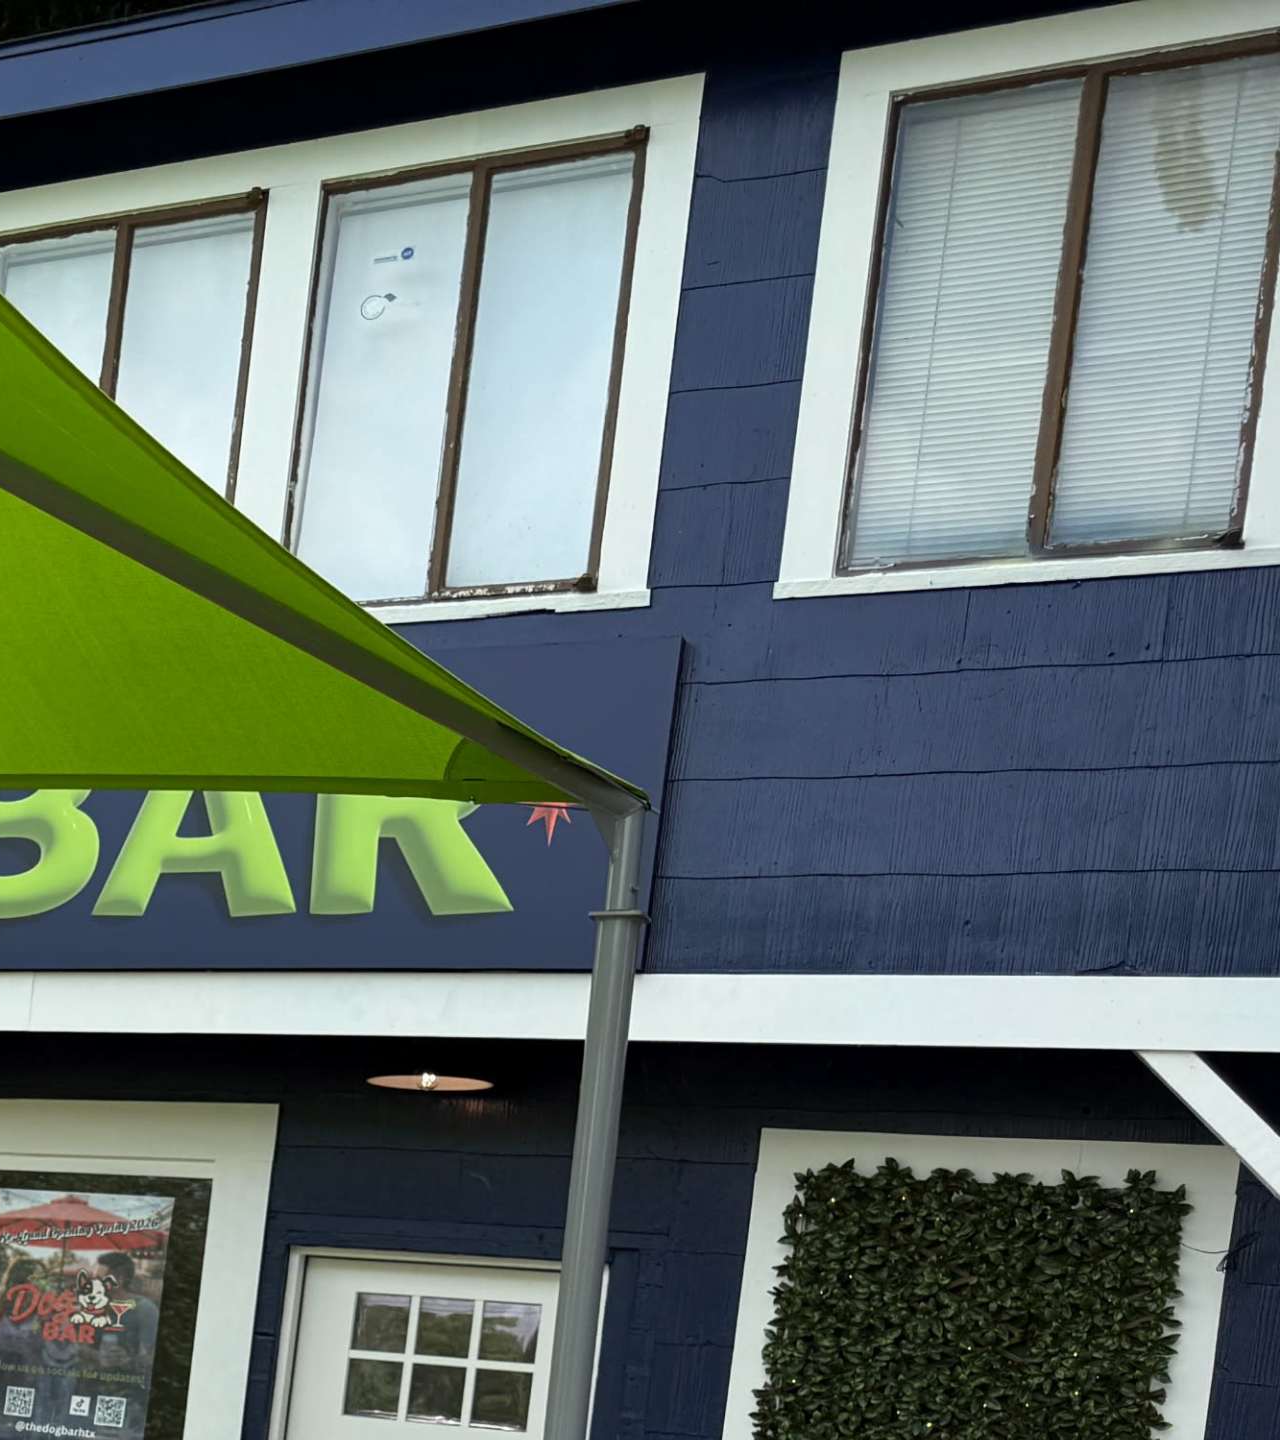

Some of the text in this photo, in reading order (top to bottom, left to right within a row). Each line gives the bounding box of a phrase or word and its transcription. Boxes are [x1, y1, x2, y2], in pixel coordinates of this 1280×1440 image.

[6, 1283, 76, 1324] Dog
[43, 1322, 96, 1344] BAR
[15, 1420, 97, 1439] @thedogbarhtx
